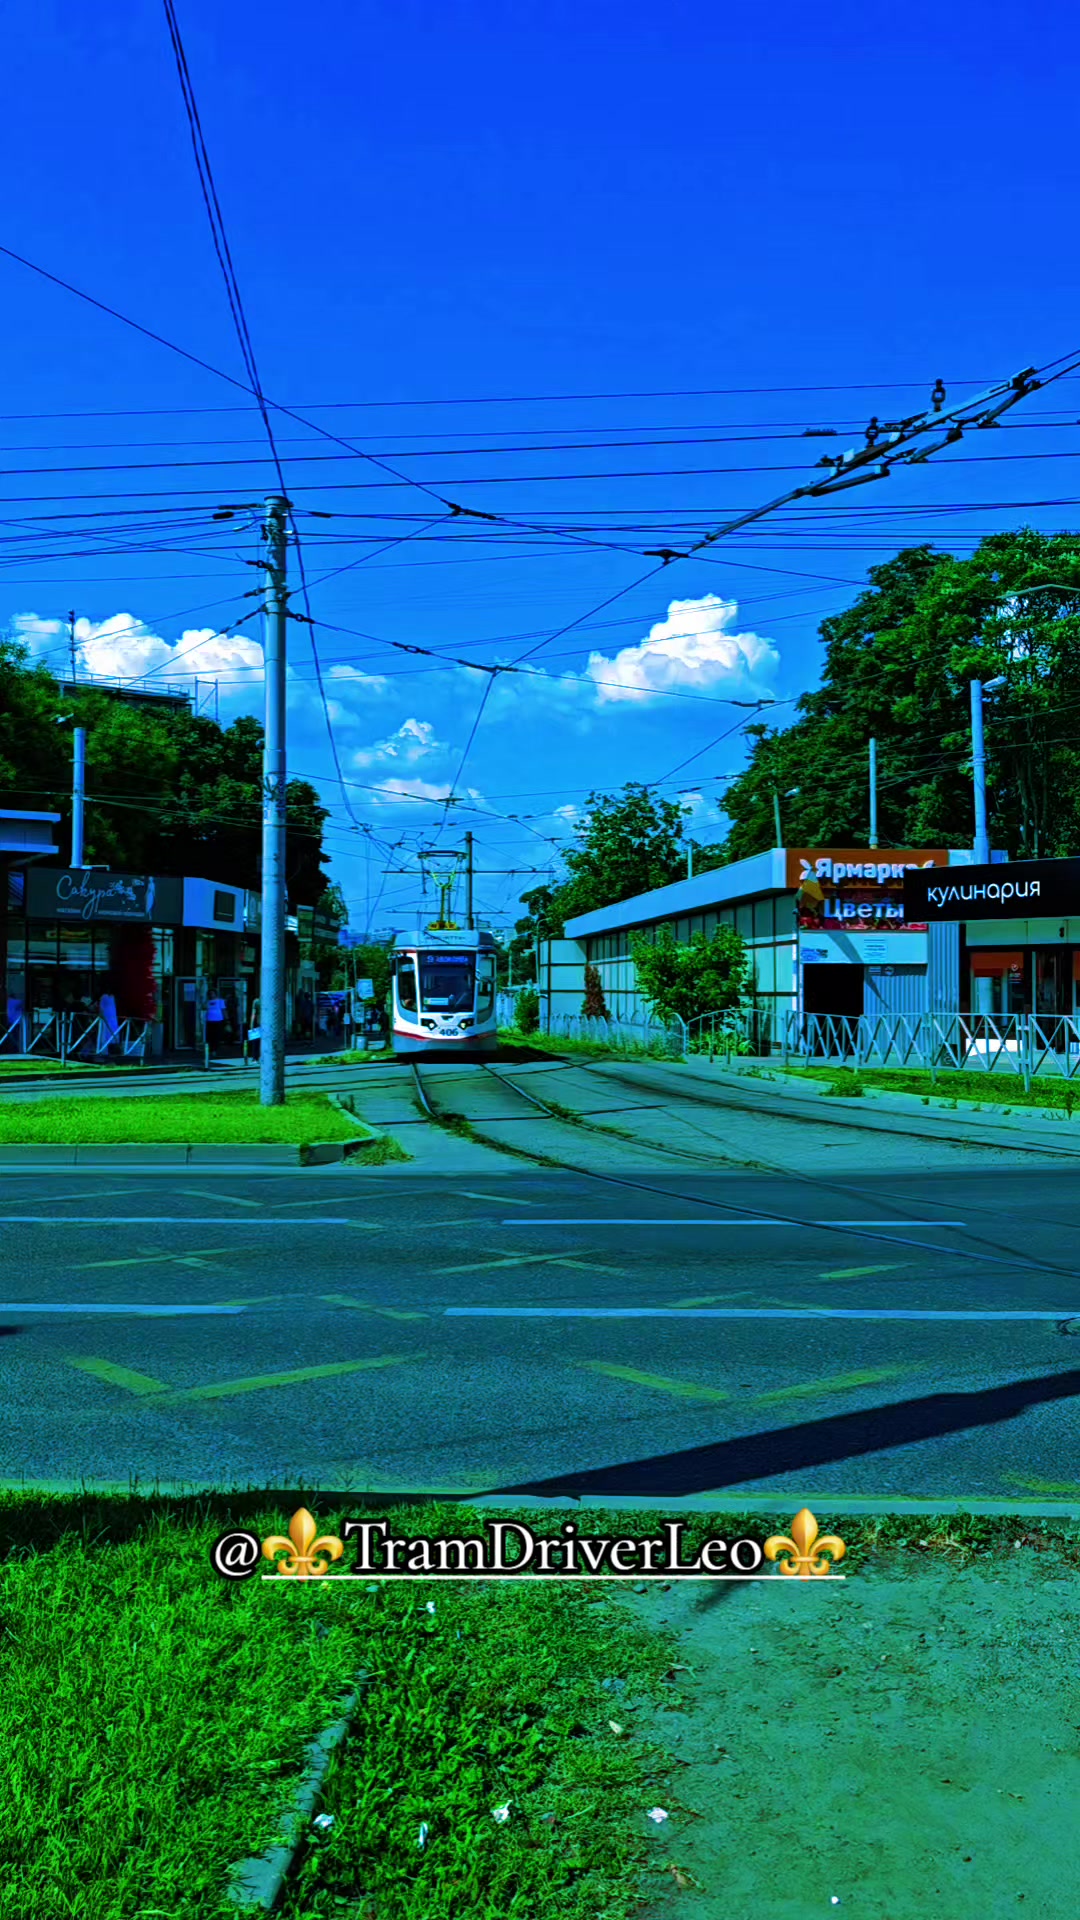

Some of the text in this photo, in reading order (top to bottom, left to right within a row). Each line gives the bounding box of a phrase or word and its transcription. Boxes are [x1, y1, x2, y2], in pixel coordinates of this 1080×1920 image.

[927, 880, 1041, 908] кулинария
[823, 898, 905, 922] Цветы
[439, 1027, 459, 1037] 406
